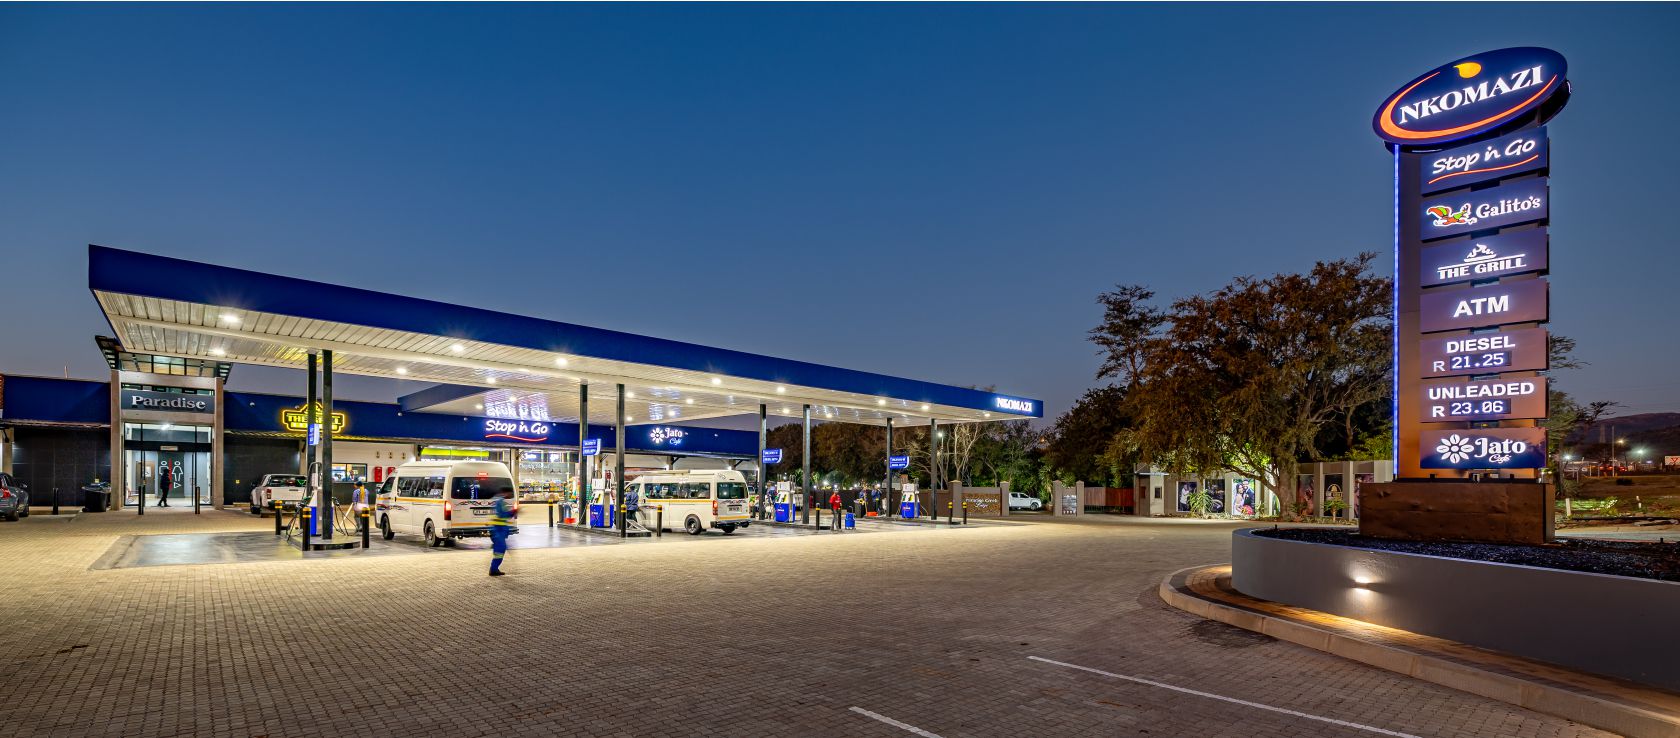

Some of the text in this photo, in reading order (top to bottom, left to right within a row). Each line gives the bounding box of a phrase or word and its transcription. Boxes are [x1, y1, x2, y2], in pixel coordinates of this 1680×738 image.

[1399, 65, 1543, 125] NKOMAZI
[1432, 152, 1479, 174] Stop
[1504, 138, 1536, 157] Go
[1475, 196, 1541, 220] Galito's
[1437, 255, 1527, 280] THE GRILL
[1453, 294, 1510, 318] ATM
[1446, 335, 1516, 354] DIESEL
[1433, 352, 1505, 373] R 21.25
[1429, 382, 1535, 400] UNLEADED
[131, 395, 206, 409] Paradise
[996, 397, 1033, 412] NKOMAZI
[1432, 400, 1504, 418] R 23.06
[485, 420, 517, 436] Stop
[530, 422, 548, 434] Go
[664, 427, 683, 439] Jato
[1473, 437, 1527, 458] Jato
